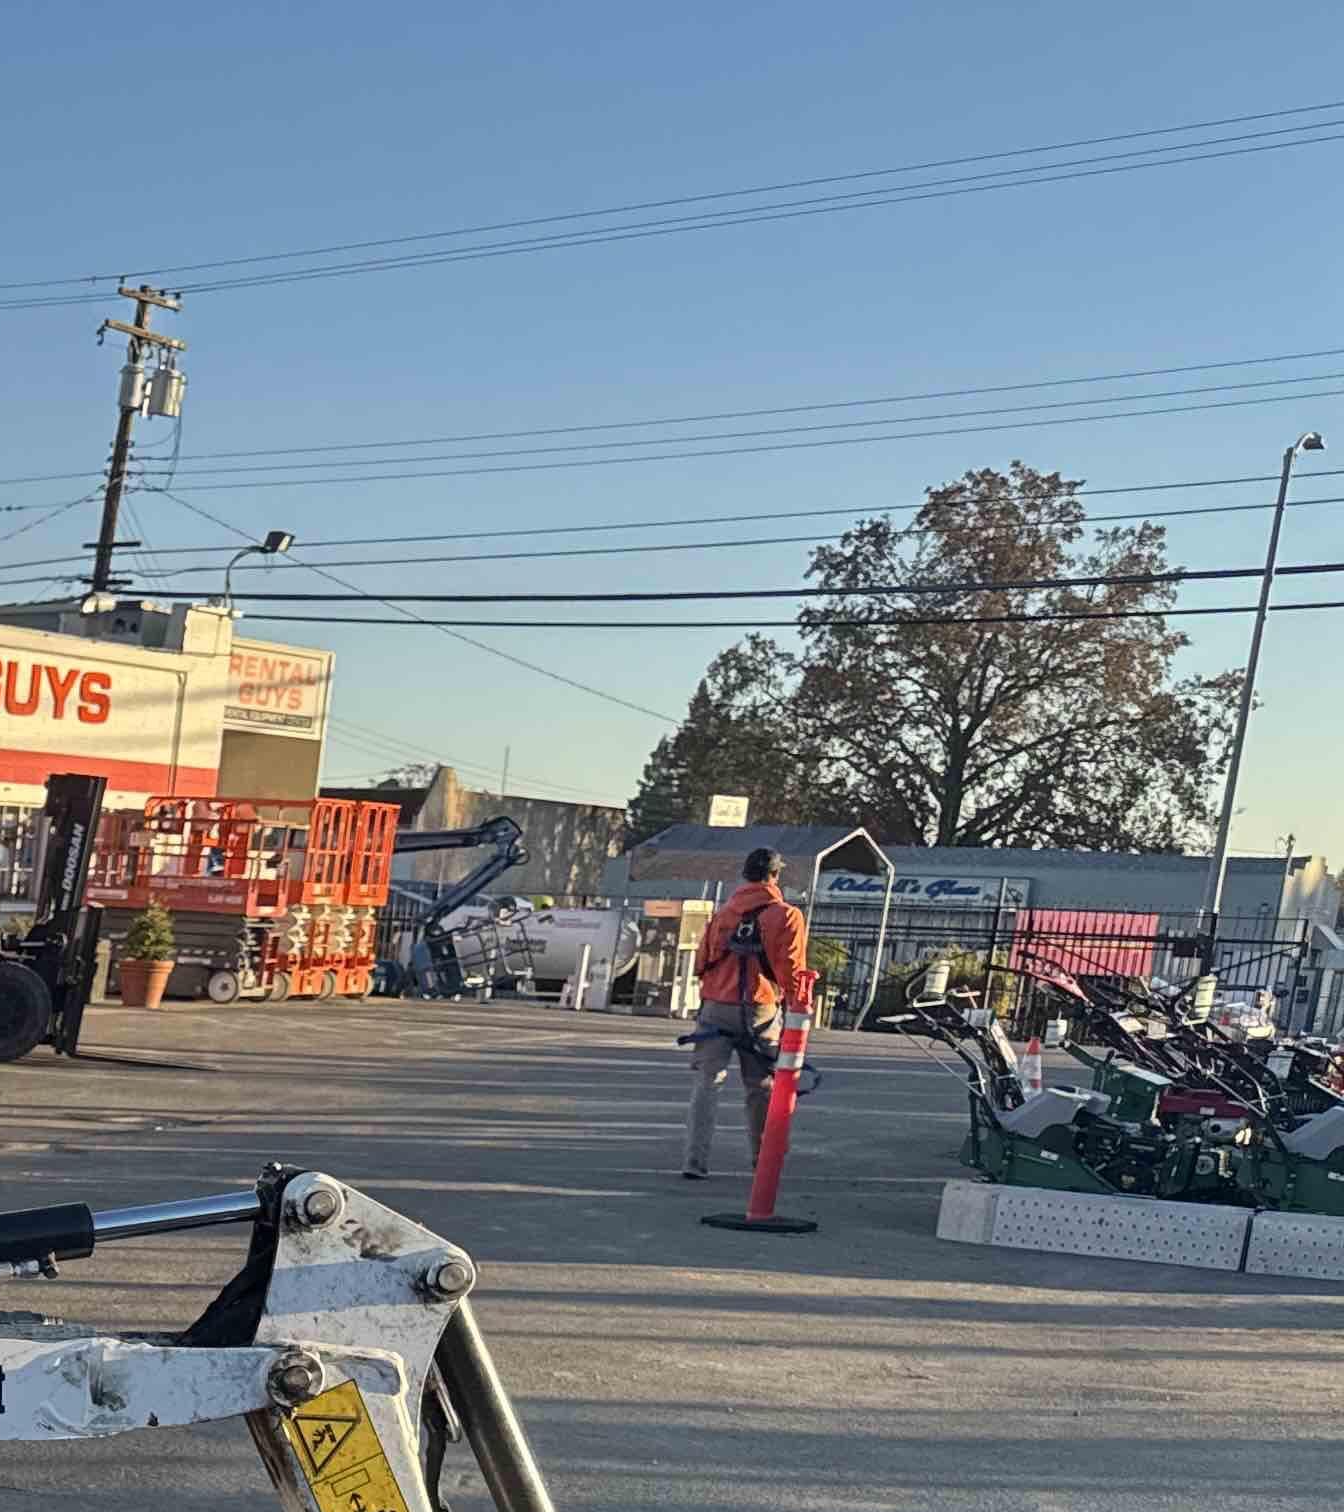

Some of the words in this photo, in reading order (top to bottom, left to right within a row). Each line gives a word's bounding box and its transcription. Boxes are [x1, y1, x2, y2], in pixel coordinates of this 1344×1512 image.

[229, 654, 316, 686] RENTAL
[239, 683, 303, 710] GUYS
[63, 823, 85, 890] DOOSAN
